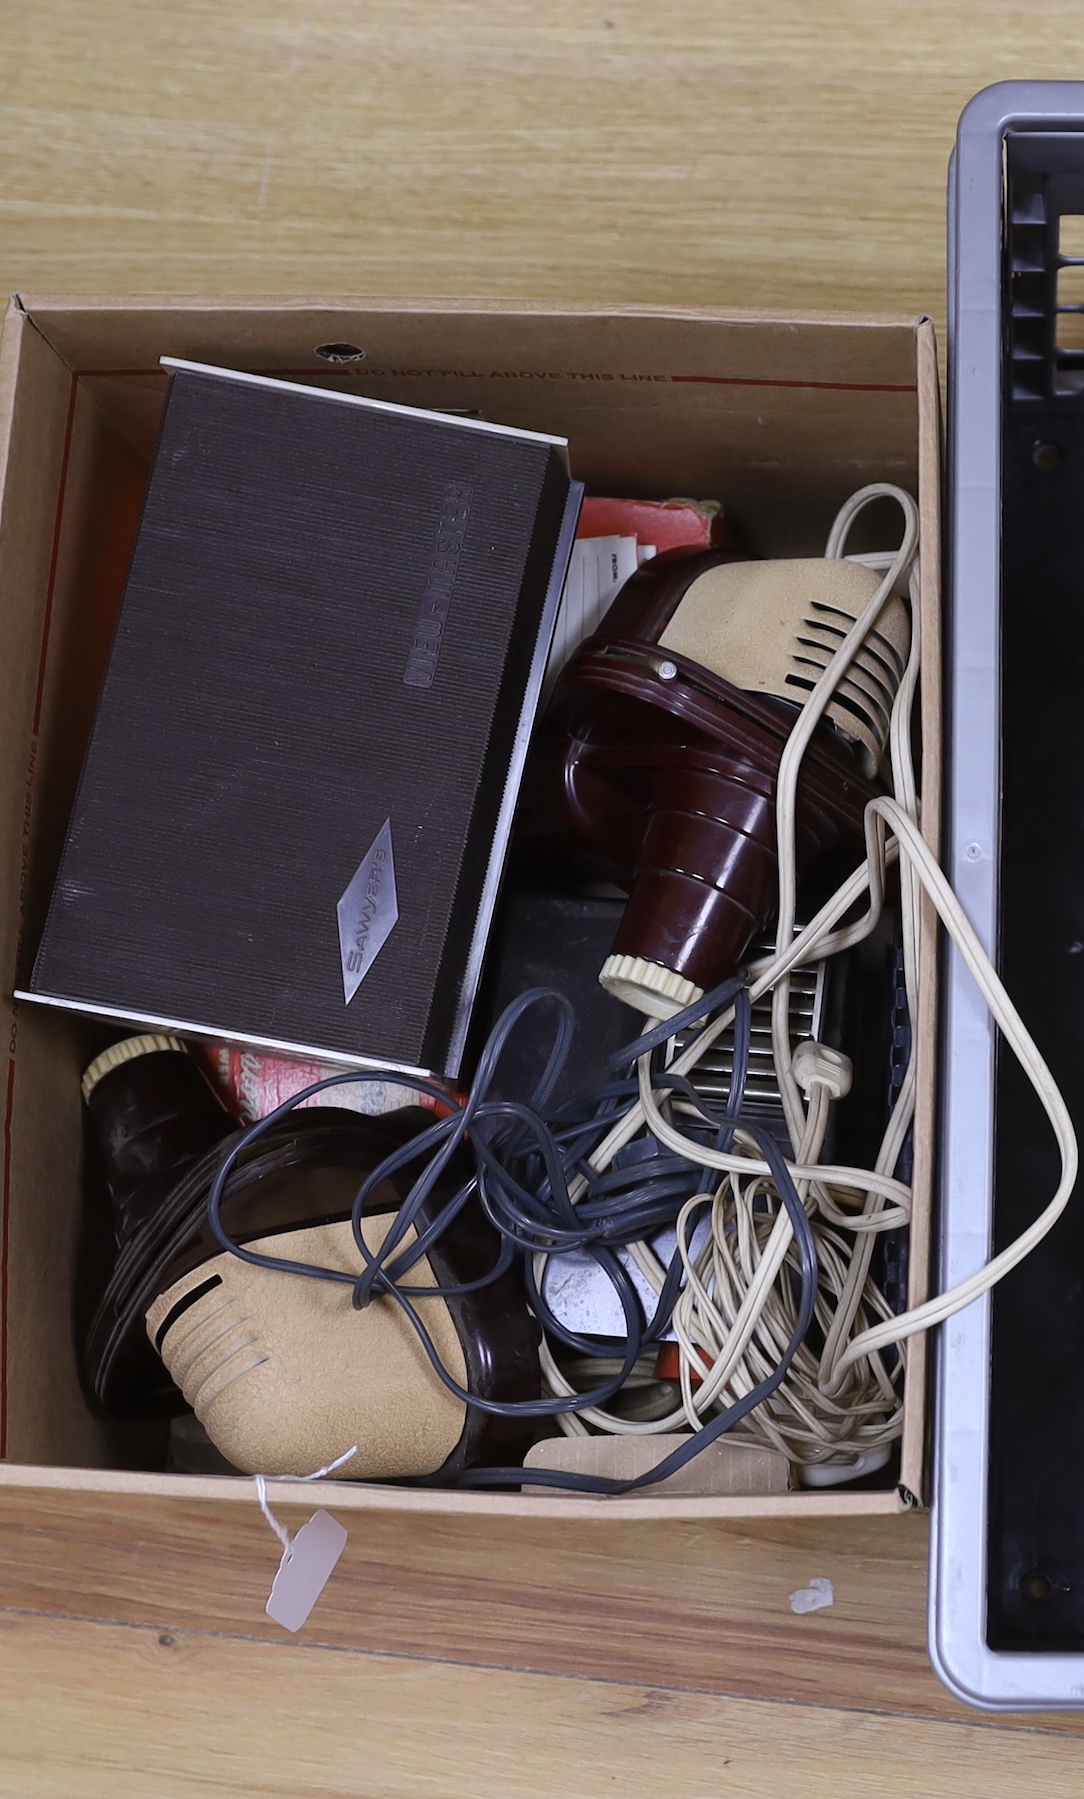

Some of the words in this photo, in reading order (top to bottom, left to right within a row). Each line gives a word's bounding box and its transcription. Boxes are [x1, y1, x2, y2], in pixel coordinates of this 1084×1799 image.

[354, 369, 387, 377] DO
[392, 369, 436, 378] NOT
[440, 370, 485, 378] FILL
[489, 371, 563, 379] ABOVE
[566, 372, 614, 381] THIS
[620, 373, 669, 382] LINE
[25, 739, 38, 787] LINE
[22, 792, 32, 837] THIS
[9, 1023, 19, 1055] DO
